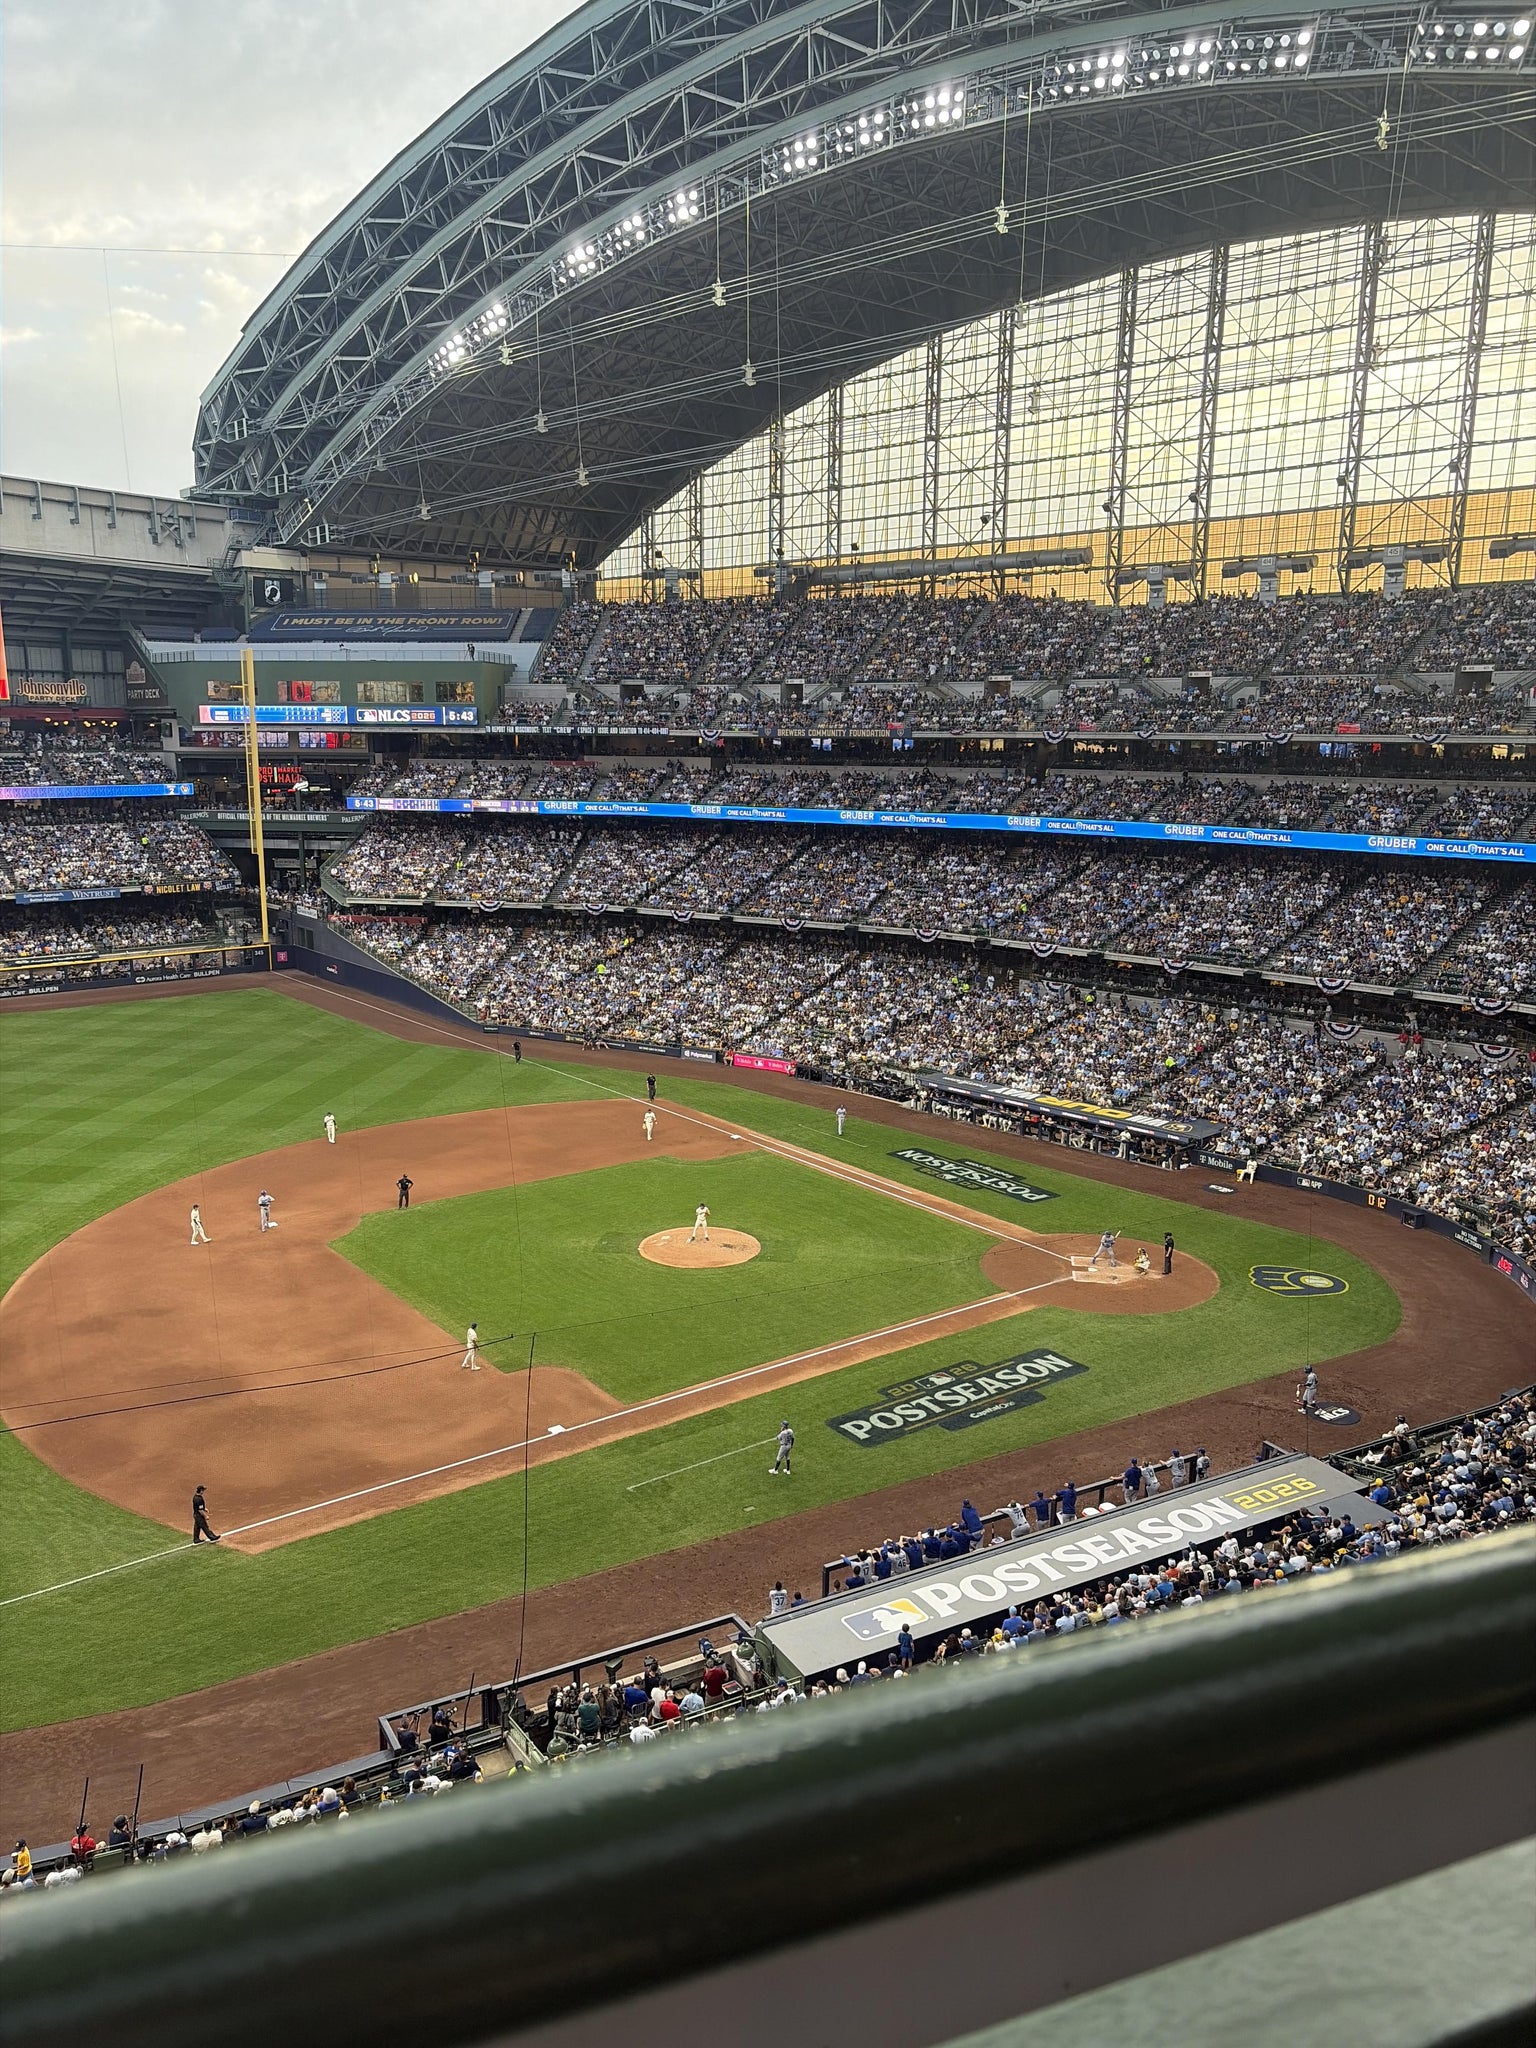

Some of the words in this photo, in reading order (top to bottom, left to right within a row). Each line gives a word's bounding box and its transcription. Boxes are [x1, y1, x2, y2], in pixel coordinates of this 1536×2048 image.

[17, 677, 87, 696] Johnsonville
[127, 690, 144, 699] PARTY
[145, 688, 160, 698] DECK
[378, 709, 411, 722] NLCS
[449, 711, 474, 721] 5:43
[777, 729, 806, 737] BREWERS
[808, 729, 846, 737] COMMUNITY
[849, 729, 890, 737] FOUNDATION
[355, 799, 374, 808] 5:43
[544, 801, 578, 810] GRUBER
[691, 806, 721, 814] GRUBER
[840, 811, 874, 820] GRUBER
[1007, 816, 1041, 827] GRUBER
[1048, 821, 1060, 829] ONE
[1061, 822, 1077, 830] CALL
[1082, 823, 1102, 831] THAT'S
[1103, 824, 1114, 832] ALL
[1165, 825, 1204, 836] GRUBER
[1212, 830, 1227, 838] ONE
[1229, 831, 1247, 840] CALL
[1254, 832, 1278, 841] THAT'S
[1279, 834, 1292, 842] ALL
[1368, 836, 1416, 849] GRUBER
[1427, 843, 1445, 851] ONE
[1447, 844, 1468, 853] CALL
[1477, 846, 1507, 855] THAT'S
[1508, 848, 1525, 856] ALL
[156, 885, 184, 893] NICOLET
[186, 884, 201, 892] LAW
[194, 969, 220, 978] BULLPEN
[29, 986, 59, 994] BULLPEN
[1208, 1157, 1233, 1170] Mobile
[897, 1150, 1049, 1201] POSTSEASON
[1311, 1180, 1323, 1190] APP
[887, 1383, 918, 1398] 20
[950, 1363, 978, 1377] 26
[840, 1354, 1074, 1441] POSTSEASON
[918, 1496, 1248, 1619] POSTSEASON
[1233, 1476, 1317, 1510] 2026
[863, 1568, 870, 1576] 17
[774, 1597, 785, 1606] 37
